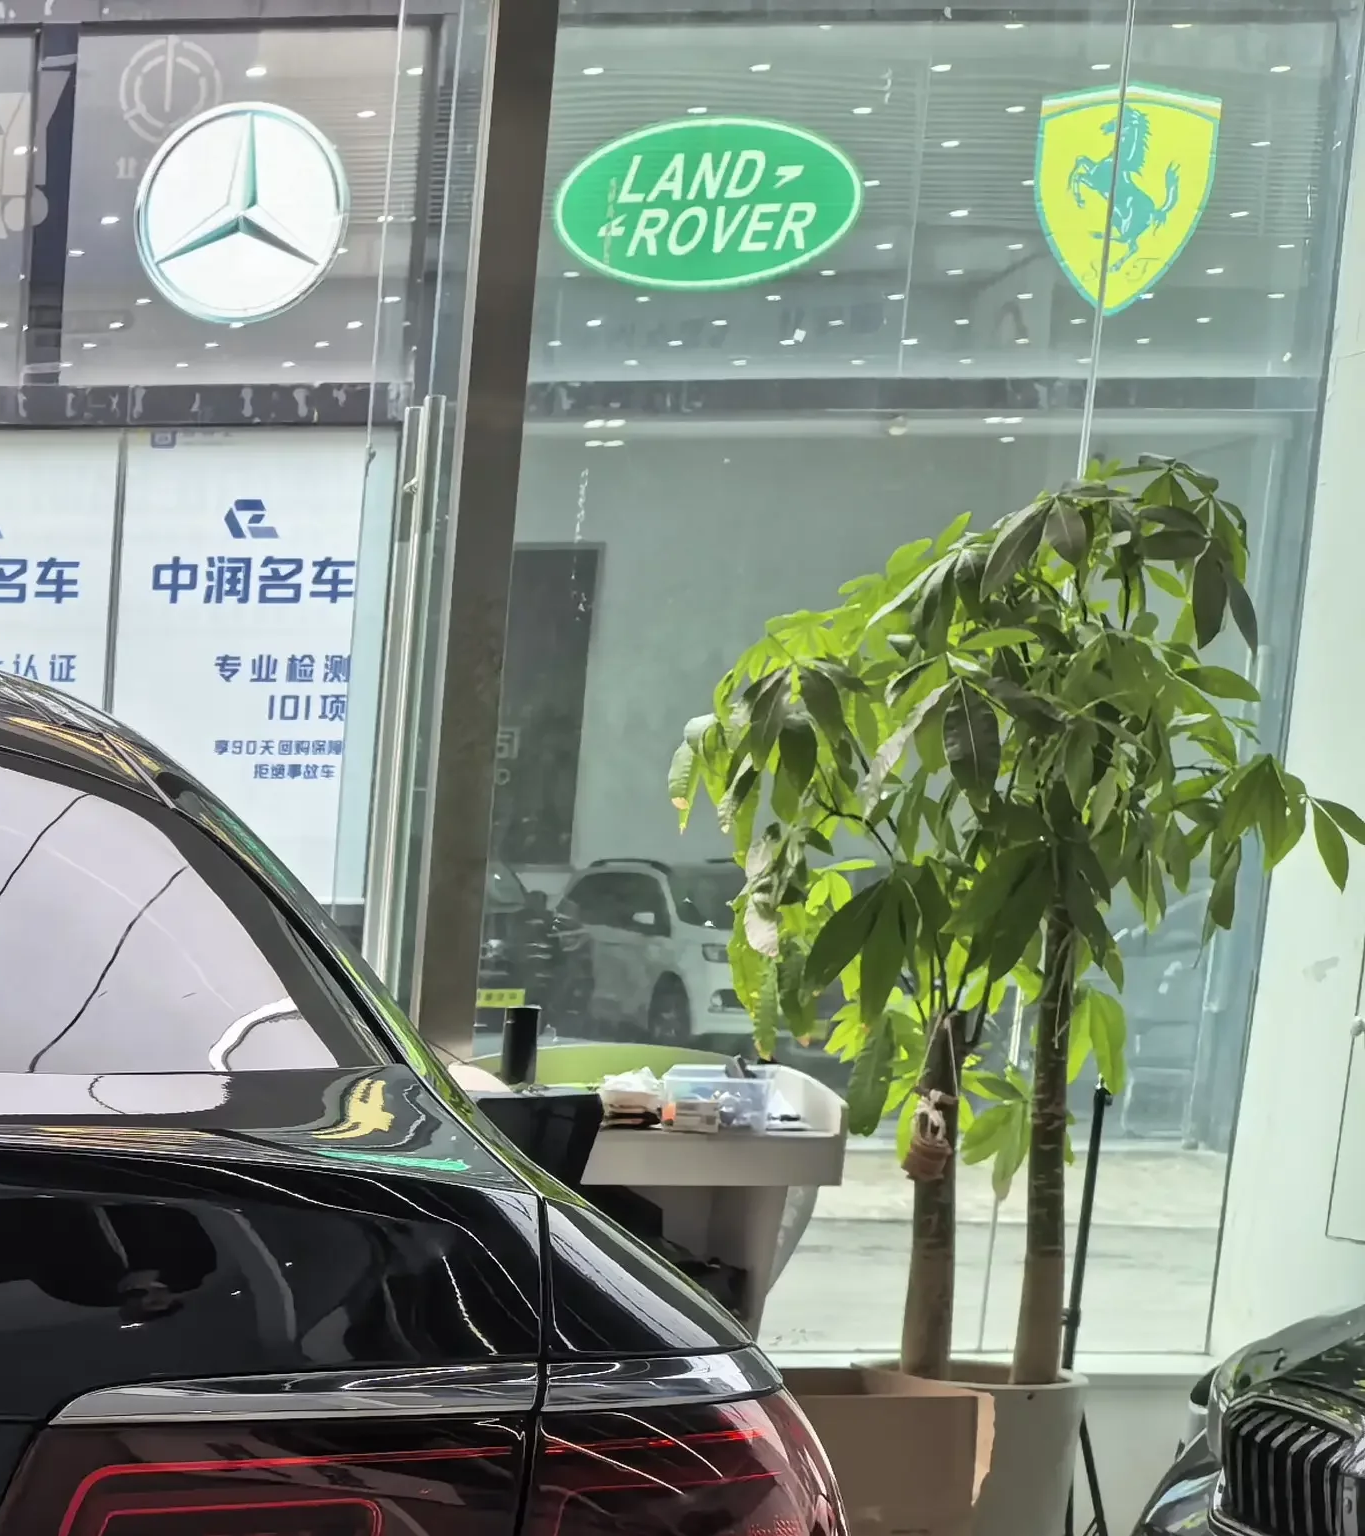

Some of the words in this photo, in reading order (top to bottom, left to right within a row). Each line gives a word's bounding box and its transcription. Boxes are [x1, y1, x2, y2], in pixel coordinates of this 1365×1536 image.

[616, 149, 767, 204] LAND
[625, 202, 817, 257] ROVER
[152, 556, 356, 604] 中润名车
[215, 653, 352, 683] 专业检测
[253, 763, 336, 780] 拒绝事故车
